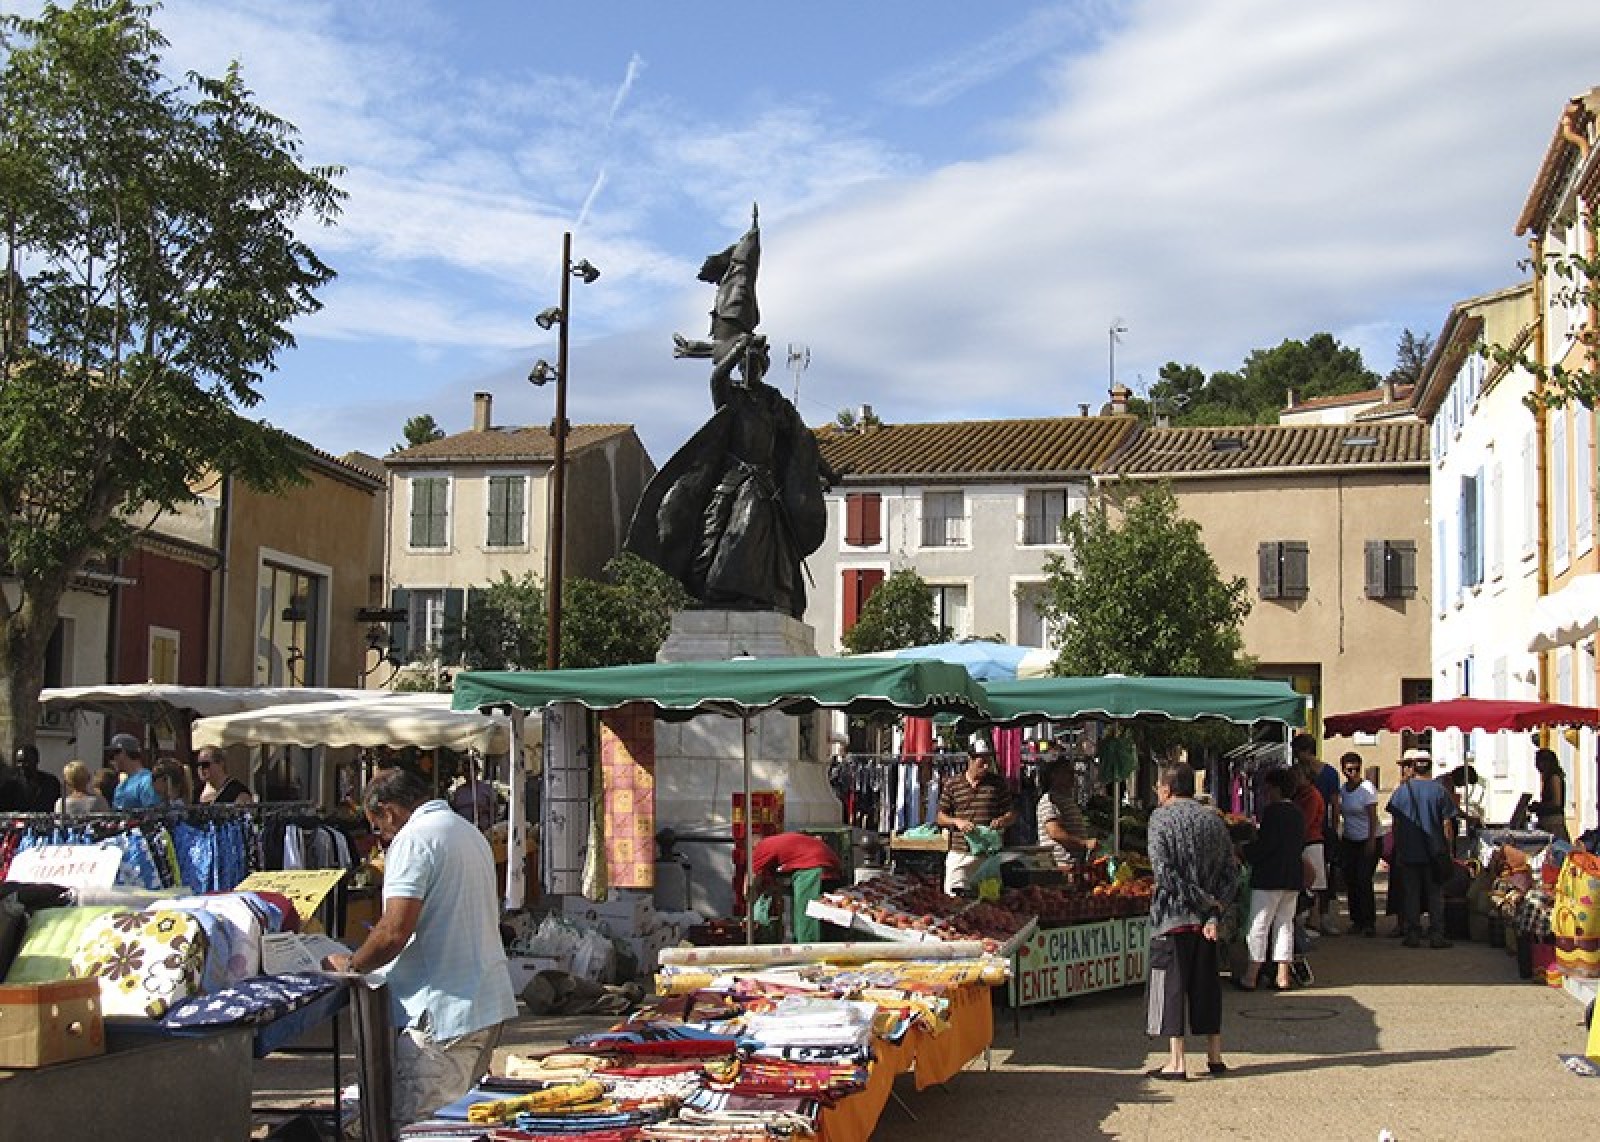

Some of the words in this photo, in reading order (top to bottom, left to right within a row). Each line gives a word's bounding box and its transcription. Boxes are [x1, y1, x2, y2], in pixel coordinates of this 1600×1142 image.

[1050, 925, 1121, 963] CHANTAL
[1127, 921, 1147, 949] ET
[1065, 955, 1121, 993] DIRECTE
[1125, 951, 1145, 981] DU
